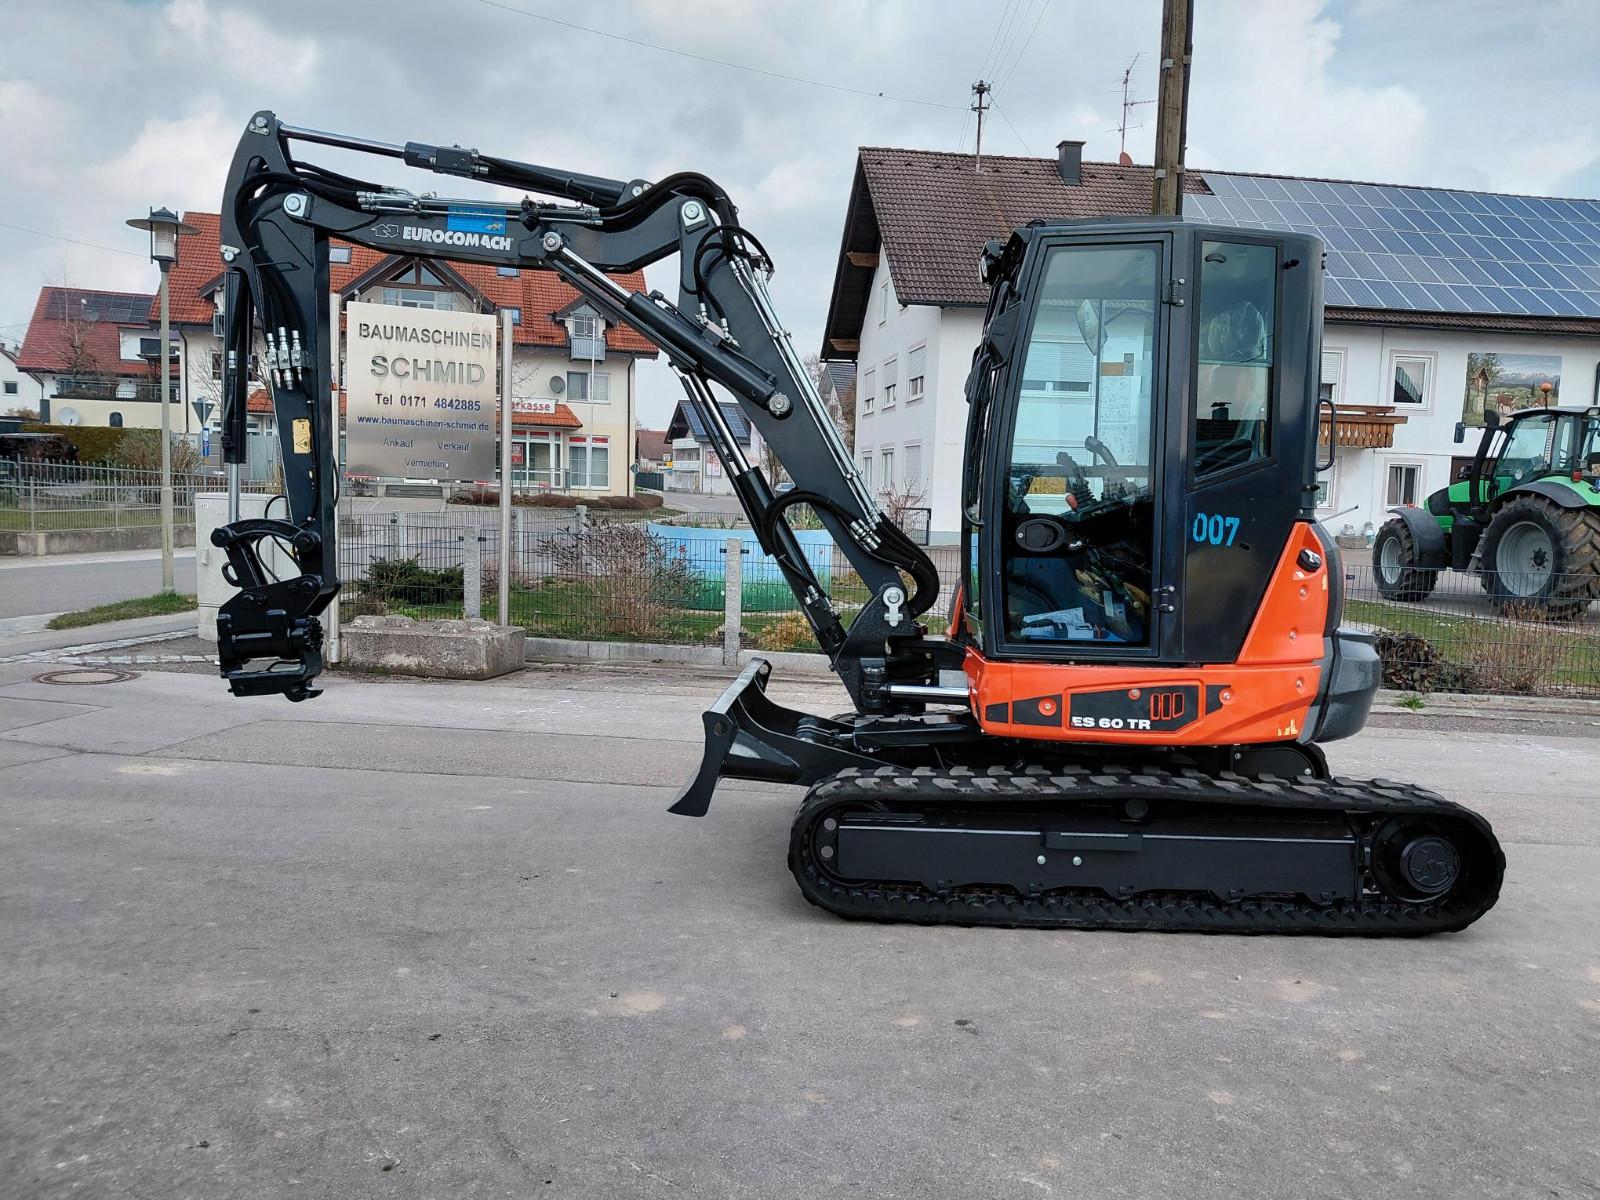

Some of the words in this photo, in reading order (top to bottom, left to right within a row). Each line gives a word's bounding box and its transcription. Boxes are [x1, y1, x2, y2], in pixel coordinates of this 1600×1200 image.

[402, 226, 512, 251] EUROCOMACH
[359, 323, 492, 349] BAUMASCHINEN
[370, 355, 486, 385] SCHMID
[375, 393, 393, 406] Tel
[400, 395, 426, 408] 0171
[434, 398, 481, 412] 4842885
[357, 415, 489, 431] www.baumaschinen-schmid.de
[383, 438, 414, 449] Ankauf
[437, 441, 470, 452] Verkauf
[405, 458, 450, 471] Vermietung
[1192, 512, 1240, 548] 007
[1071, 716, 1096, 728] ES
[1098, 717, 1124, 729] 60
[1127, 718, 1151, 730] TR
